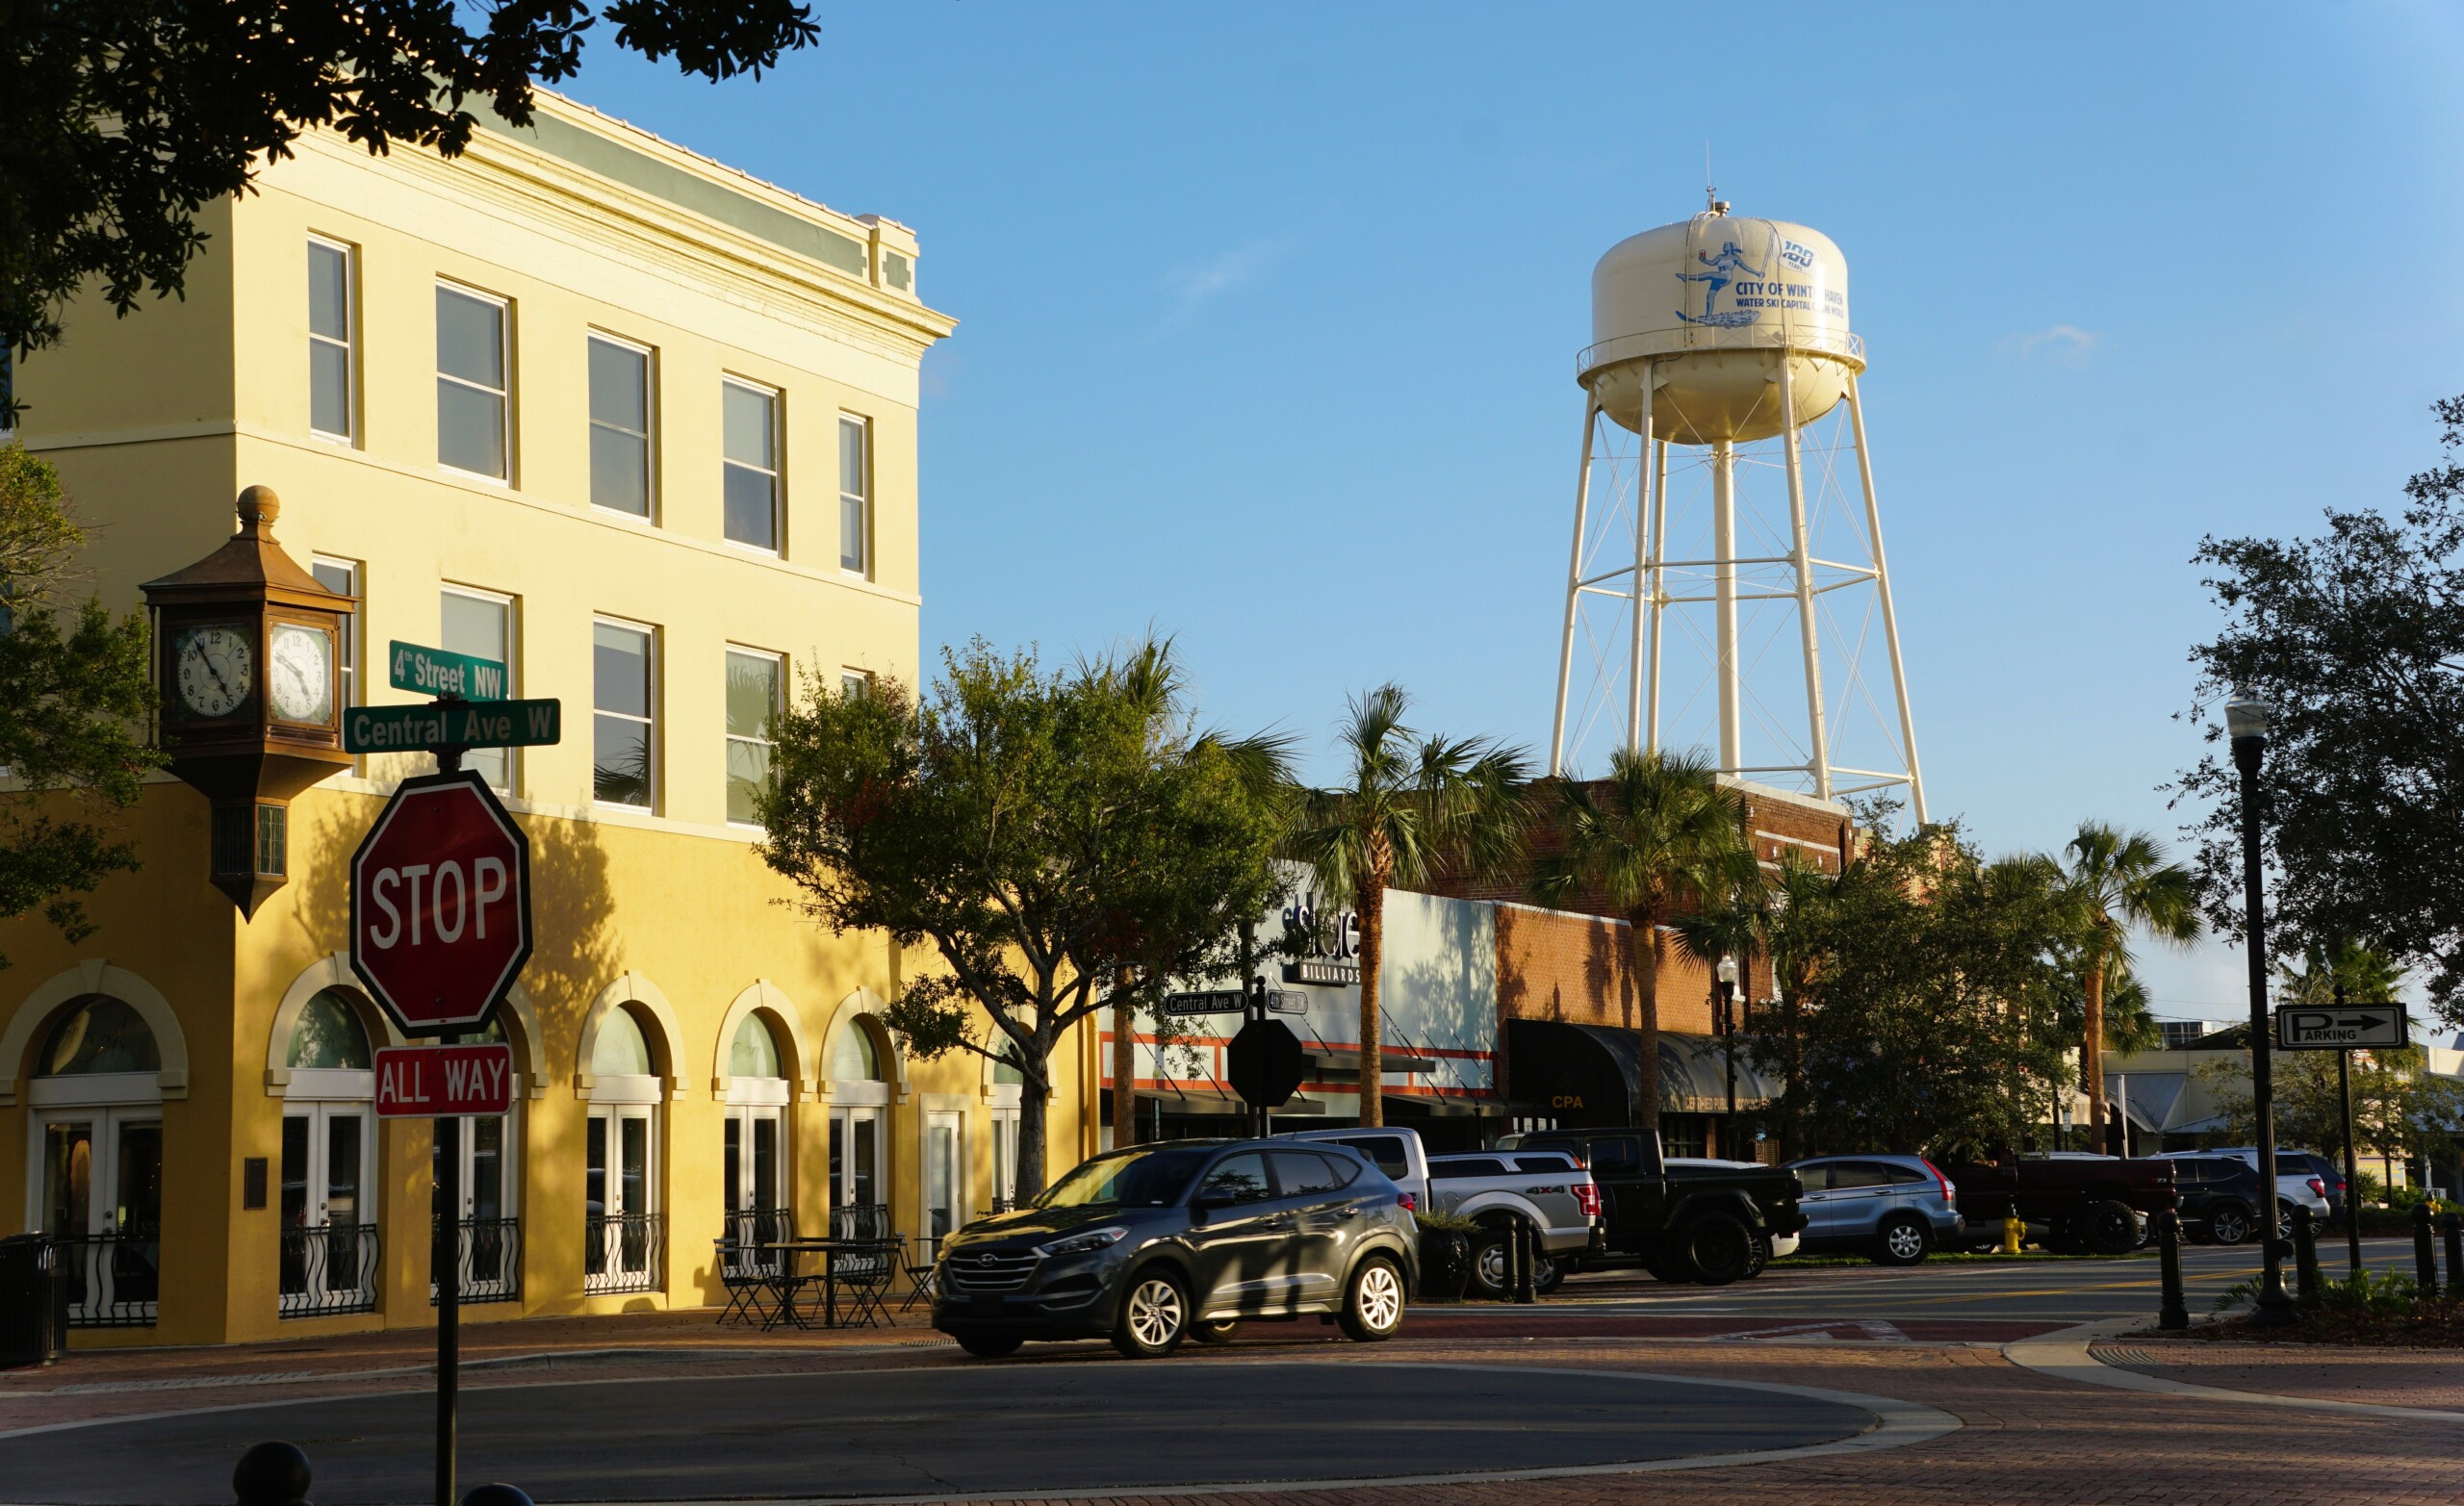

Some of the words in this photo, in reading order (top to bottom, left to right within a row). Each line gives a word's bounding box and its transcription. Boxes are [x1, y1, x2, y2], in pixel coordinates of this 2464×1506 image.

[1787, 261, 1804, 272] YEARS
[1735, 282, 1764, 295] CITY
[1768, 282, 1784, 296] OF
[1786, 283, 1817, 299] WINT
[1825, 289, 1843, 306] HAVEN
[1735, 298, 1764, 308] WATER
[1766, 298, 1780, 308] SKI
[1781, 299, 1811, 311] CAPITAL
[210, 632, 221, 644] 12
[283, 637, 290, 650] 11
[293, 634, 301, 647] 12
[188, 650, 197, 662] 10
[237, 647, 244, 659] 2
[314, 654, 319, 666] 2
[183, 668, 191, 680] 9
[241, 664, 248, 676] 3
[273, 667, 278, 678] 9
[394, 649, 414, 682] 4th
[415, 652, 466, 694] Street
[475, 664, 501, 700] NW
[317, 671, 322, 683] 3
[187, 684, 194, 697] 8
[236, 680, 245, 693] 4
[276, 683, 282, 695] 8
[313, 687, 320, 700] 4
[198, 696, 205, 708] 7
[212, 699, 219, 711] 6
[225, 694, 234, 707] 5
[284, 696, 290, 708] 7
[306, 699, 312, 711] 5
[295, 702, 300, 713] 6
[353, 711, 447, 747] Central
[463, 709, 512, 742] Ave
[527, 705, 552, 739] W
[370, 855, 507, 950] STOP
[1302, 964, 1361, 983] BILLIARDS
[1169, 995, 1207, 1011] Central
[1211, 995, 1229, 1009] Ave
[1233, 993, 1243, 1008] W
[1270, 993, 1280, 1008] 4th
[1280, 993, 1296, 1009] Street
[2291, 1012, 2357, 1042] PARKING
[379, 1060, 430, 1104] ALL
[445, 1058, 507, 1102] WAY
[1552, 1095, 1584, 1109] CPA
